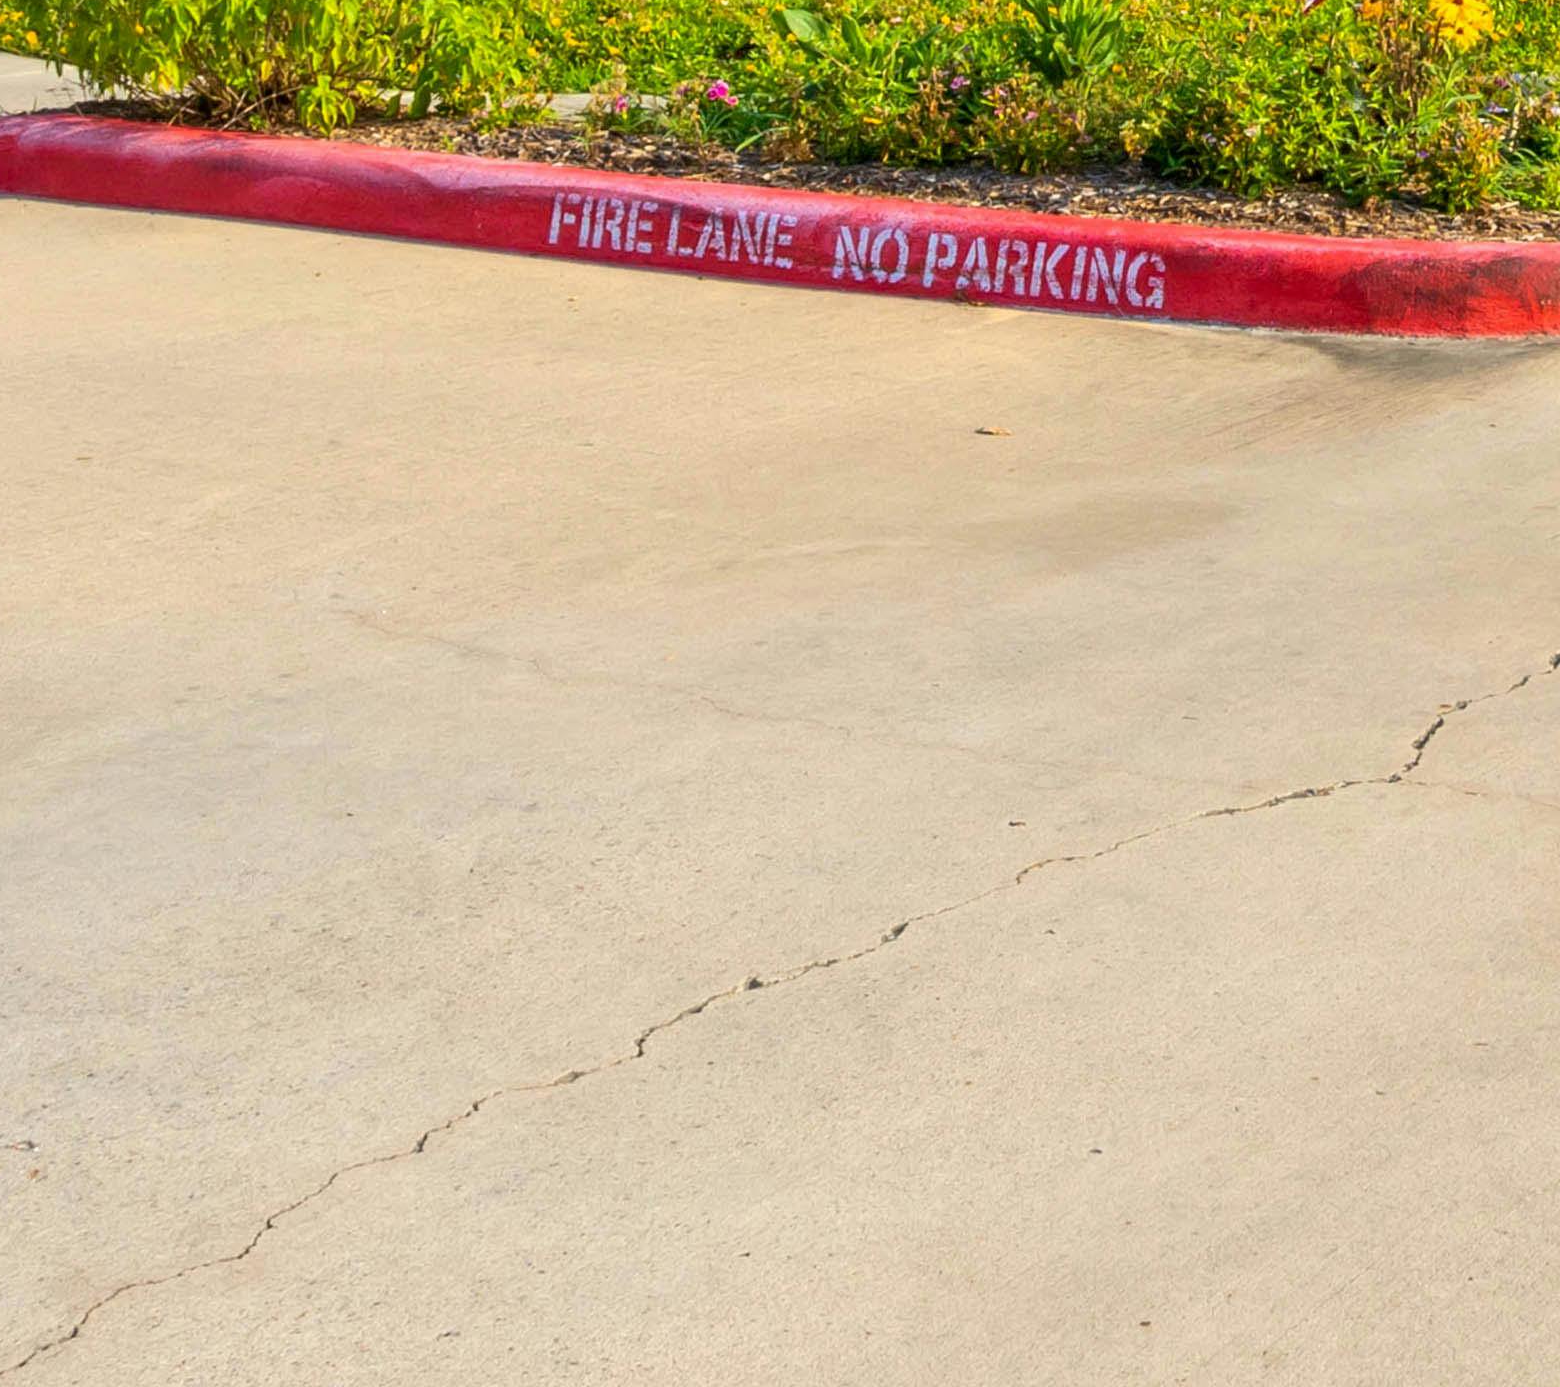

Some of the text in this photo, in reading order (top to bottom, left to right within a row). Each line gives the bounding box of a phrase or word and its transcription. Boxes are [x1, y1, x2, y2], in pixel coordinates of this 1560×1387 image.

[549, 192, 1167, 309] FIRE LANE NO PARKING
